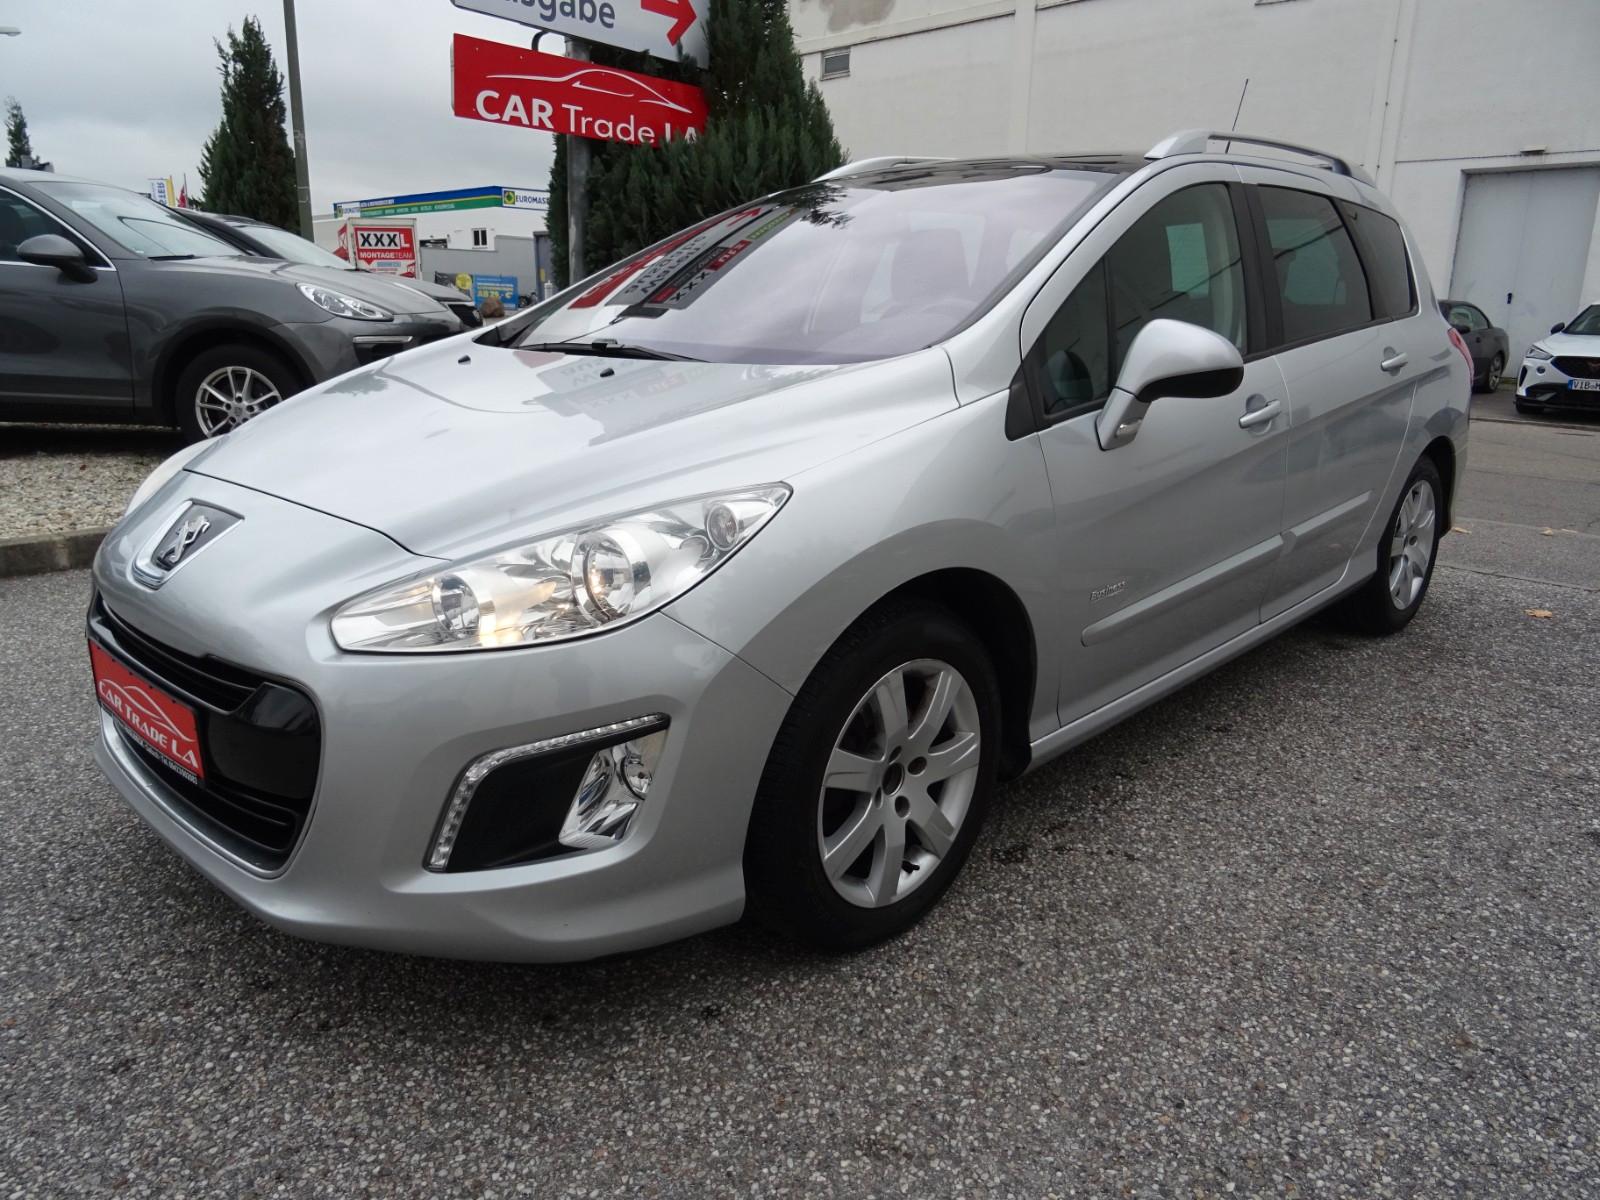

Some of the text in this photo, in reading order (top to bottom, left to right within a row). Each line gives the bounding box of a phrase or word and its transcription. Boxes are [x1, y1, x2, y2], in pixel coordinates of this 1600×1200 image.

[475, 89, 554, 129] CAR
[561, 103, 655, 144] Trade
[98, 680, 123, 713] CAR
[124, 703, 168, 749] TRADE
[171, 738, 199, 769] LA
